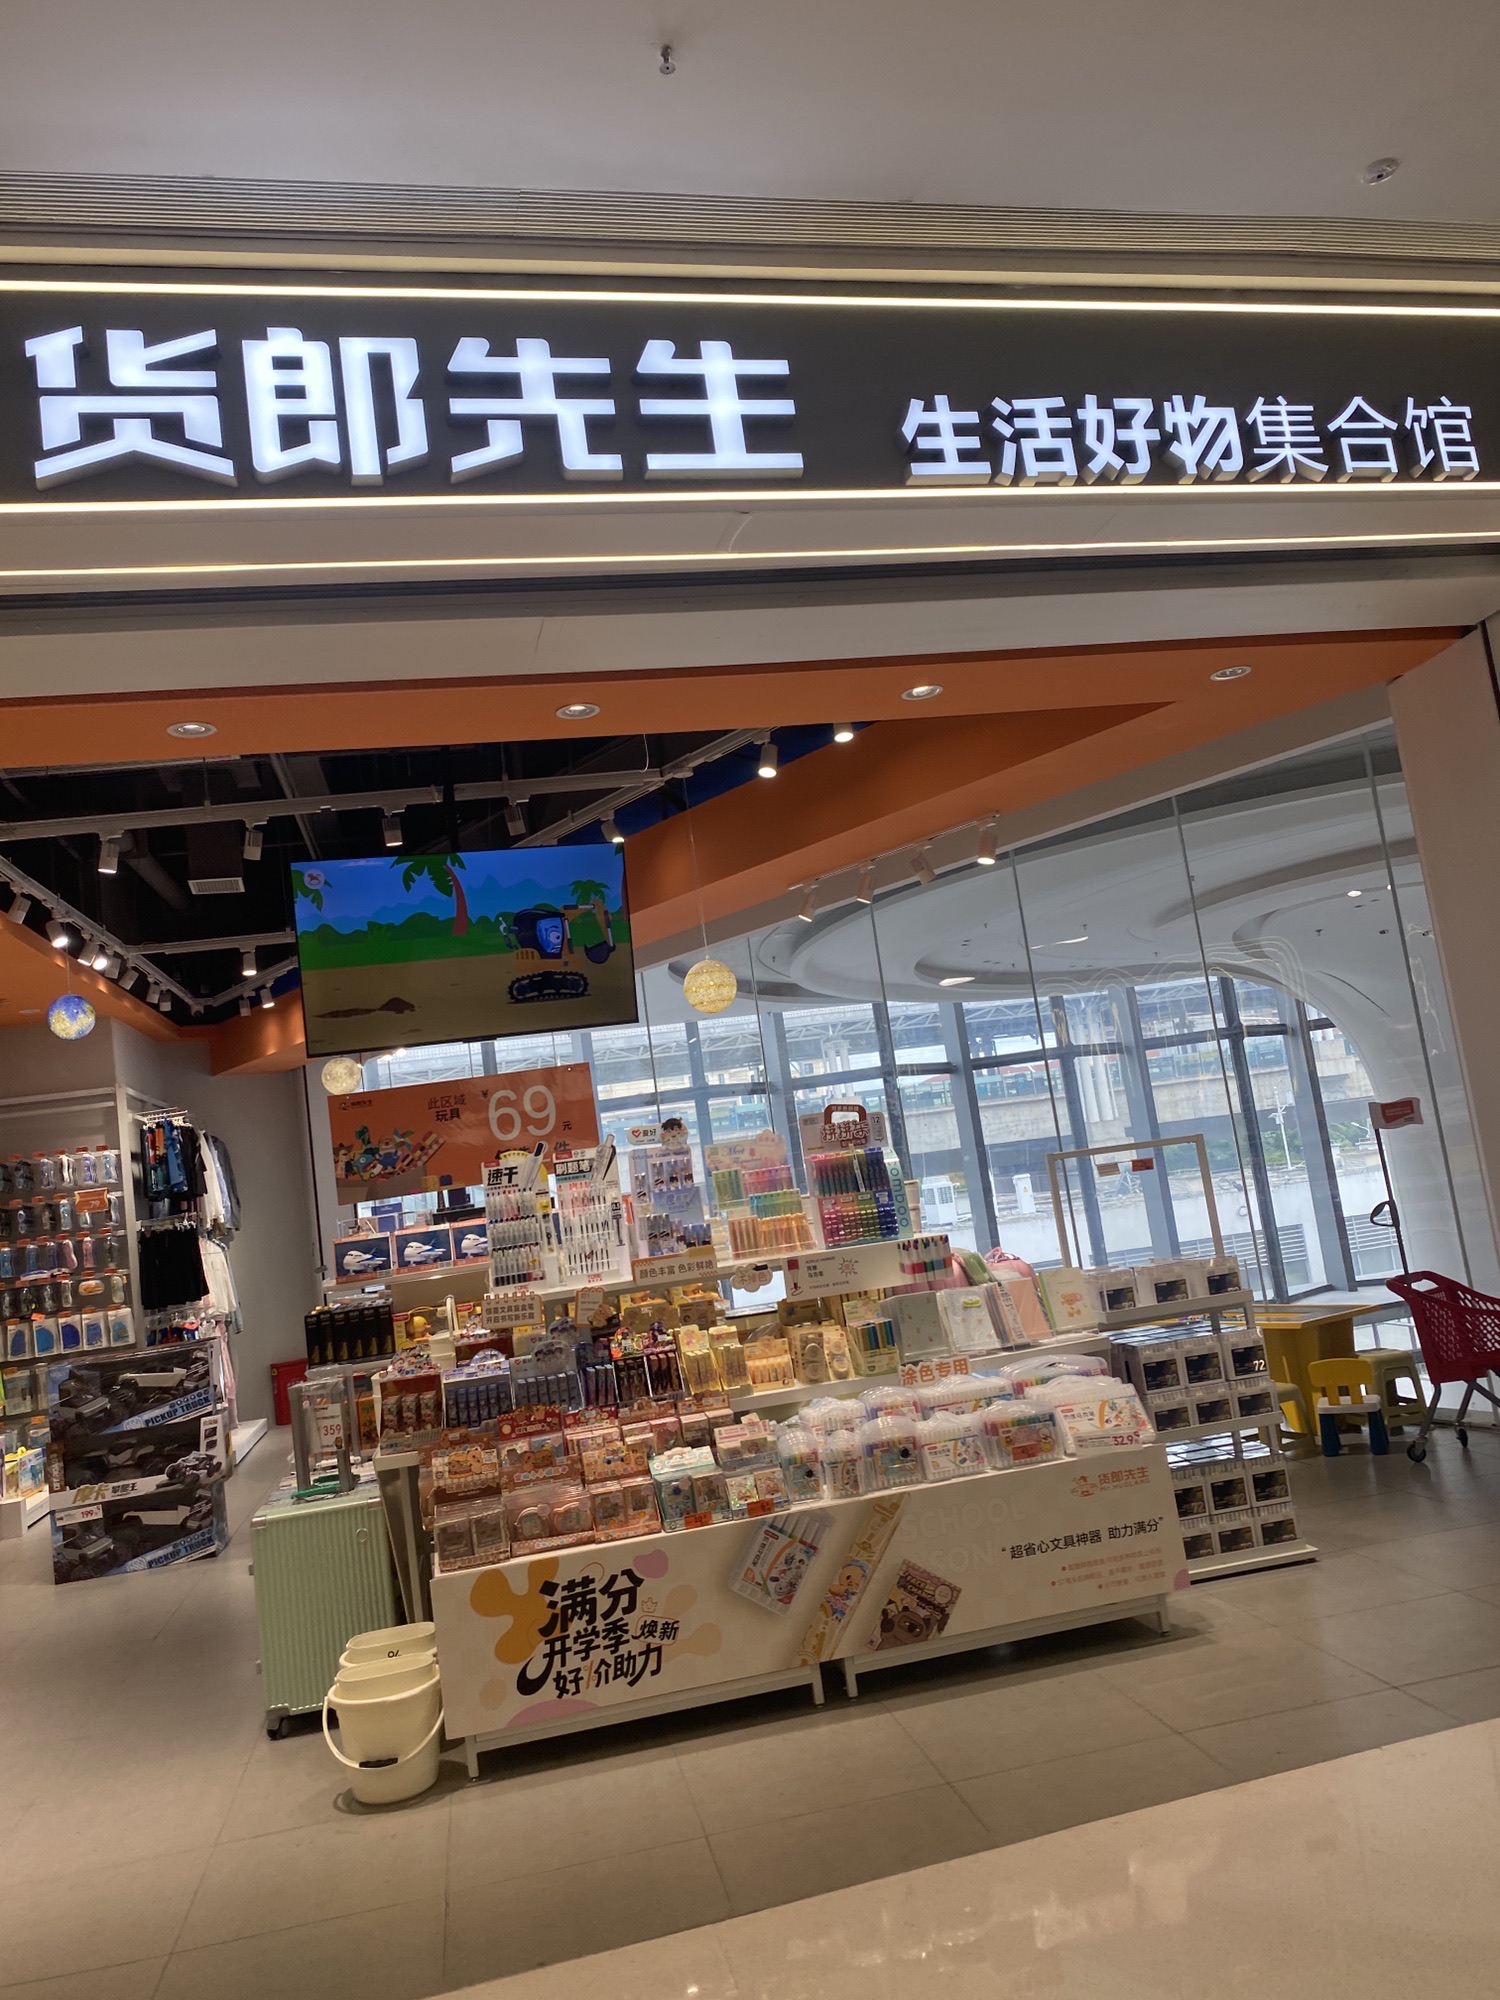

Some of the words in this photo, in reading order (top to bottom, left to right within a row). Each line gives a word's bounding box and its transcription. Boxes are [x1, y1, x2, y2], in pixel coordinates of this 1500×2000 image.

[25, 325, 805, 486] 货郎先生
[901, 393, 1481, 484] 生活好物集合馆
[427, 1094, 466, 1110] 此区域
[434, 1108, 461, 1122] 玩具
[487, 1166, 519, 1187] 速干
[555, 1160, 593, 1176] 刷题笔
[901, 1358, 969, 1386] 涂色专用
[1253, 1360, 1265, 1371] 72
[144, 1407, 179, 1427] PICKUP
[181, 1395, 211, 1413] TRUCK
[323, 1424, 341, 1436] 359
[1098, 1466, 1149, 1486] 货郎先生
[147, 1550, 182, 1569] PICKUP
[184, 1534, 215, 1554] TRUCK
[538, 1568, 645, 1637] 满分
[516, 1617, 631, 1696] 开学季
[631, 1619, 680, 1642] 焕新
